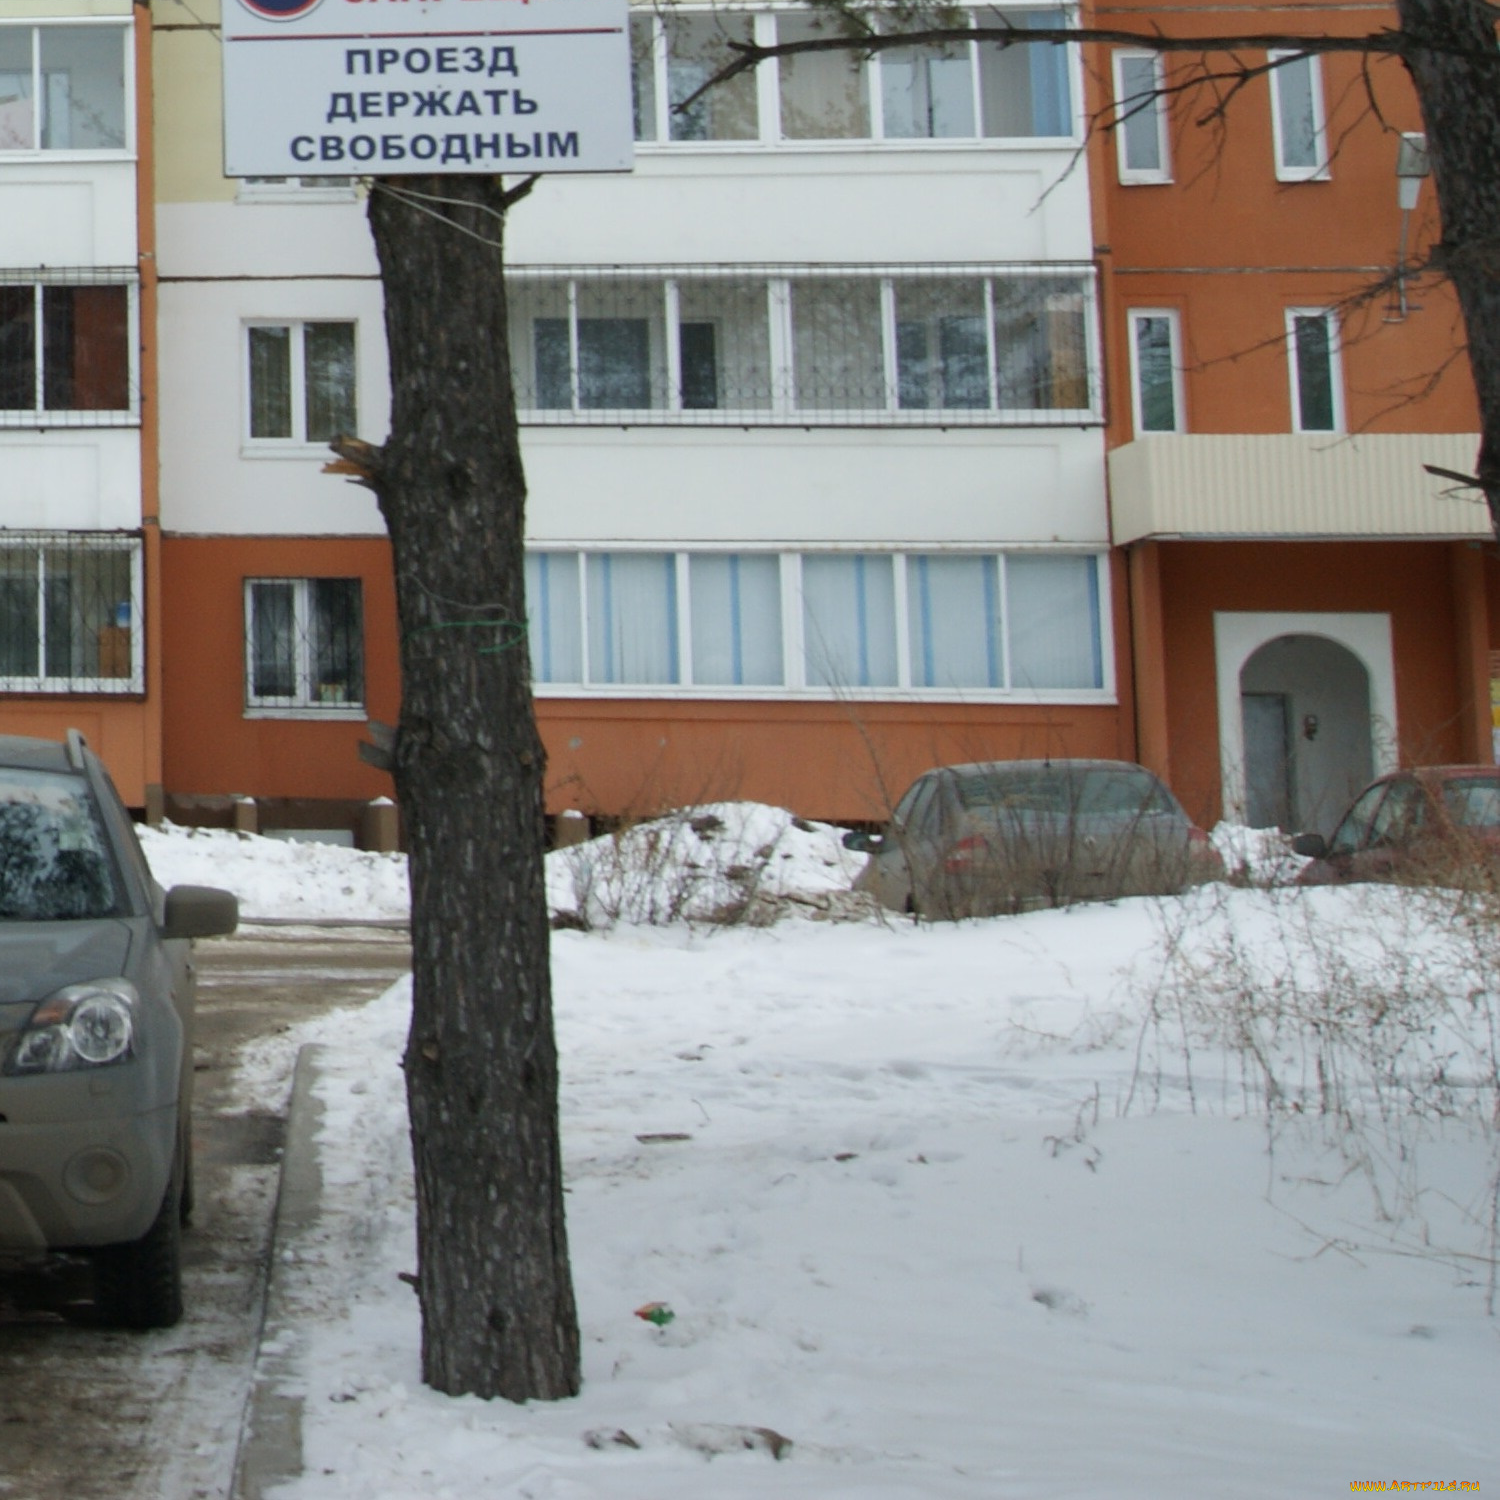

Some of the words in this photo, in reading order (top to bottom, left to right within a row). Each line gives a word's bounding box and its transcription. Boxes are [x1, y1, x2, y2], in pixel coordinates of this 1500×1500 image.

[345, 45, 519, 77] ПРОЕЗД
[326, 89, 539, 125] ДЕРЖАТЬ
[290, 131, 580, 166] СВОБОДНЫМ
